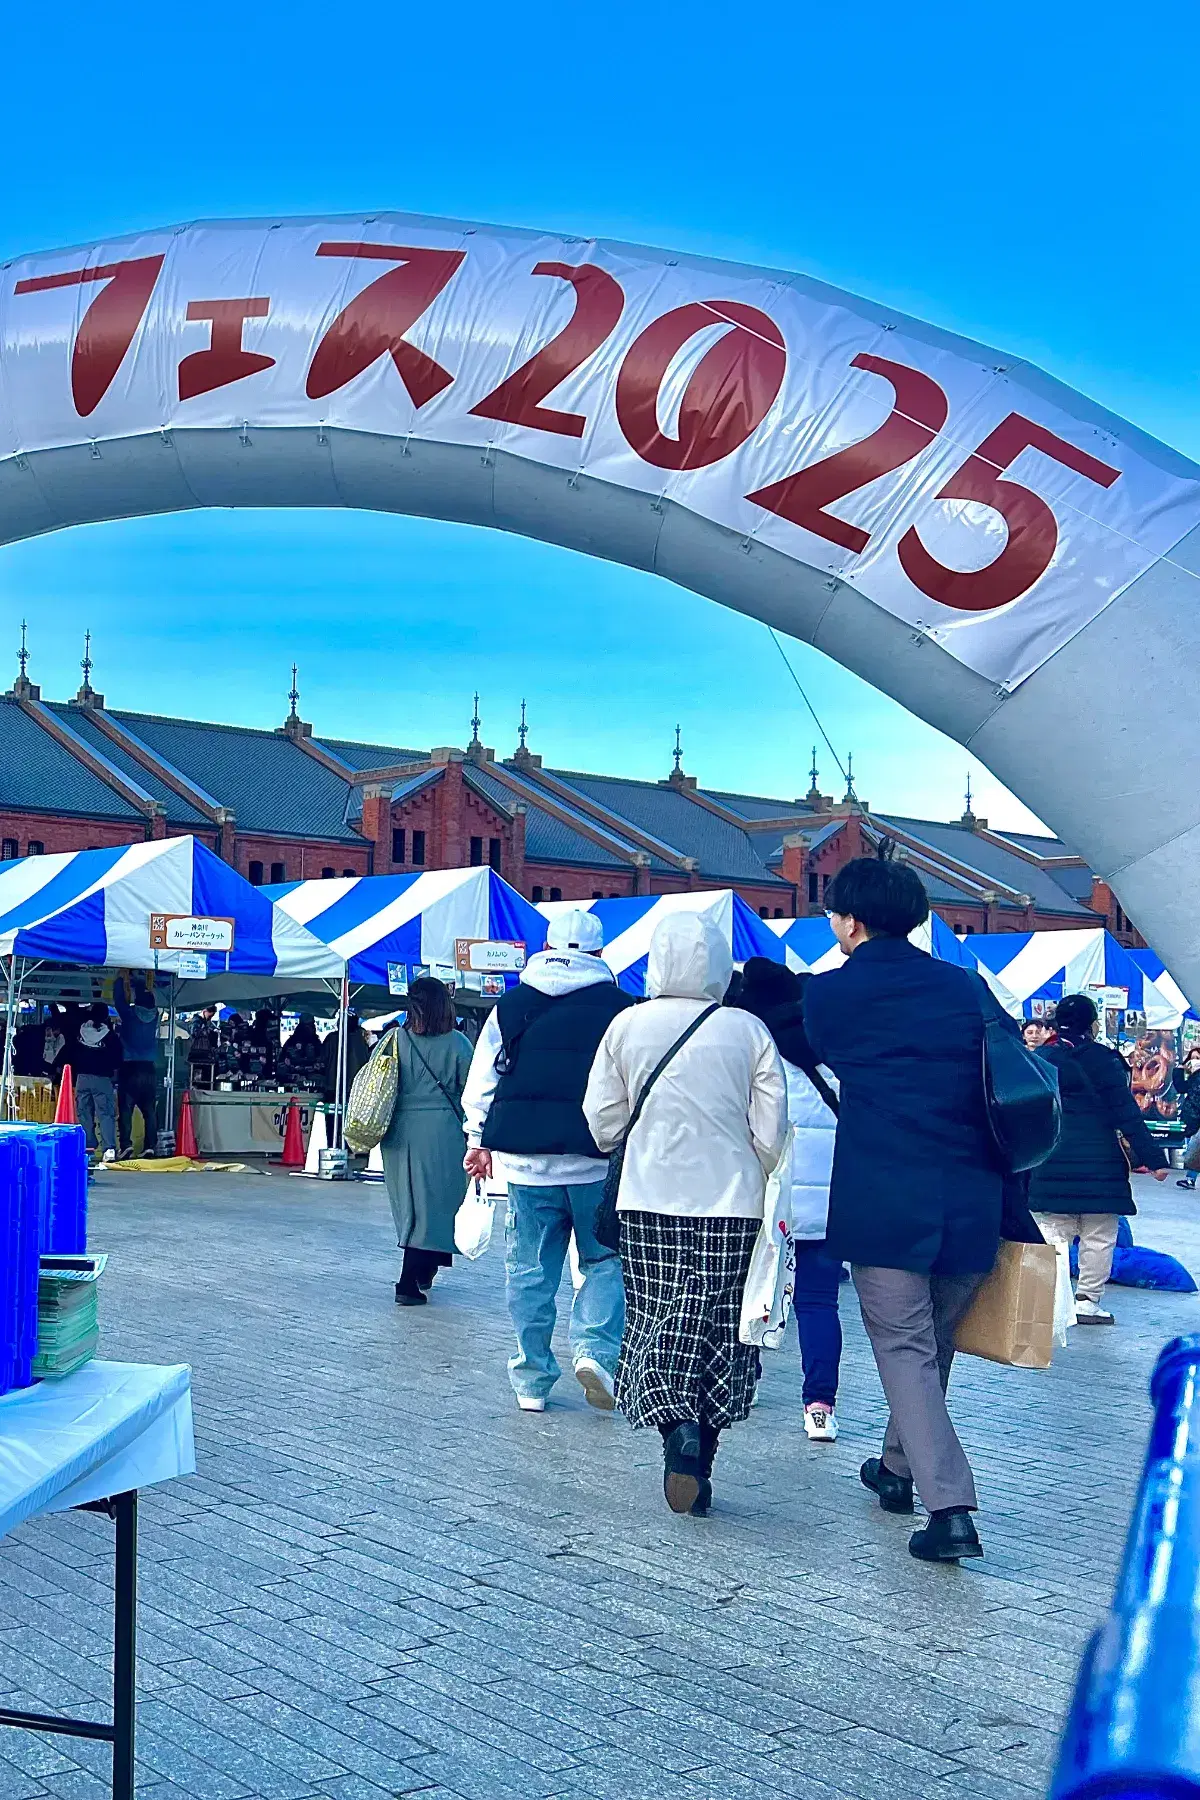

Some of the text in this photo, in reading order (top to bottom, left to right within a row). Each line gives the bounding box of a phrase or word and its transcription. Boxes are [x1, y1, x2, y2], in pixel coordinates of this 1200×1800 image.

[174, 931, 225, 940] カレーパンマーケット
